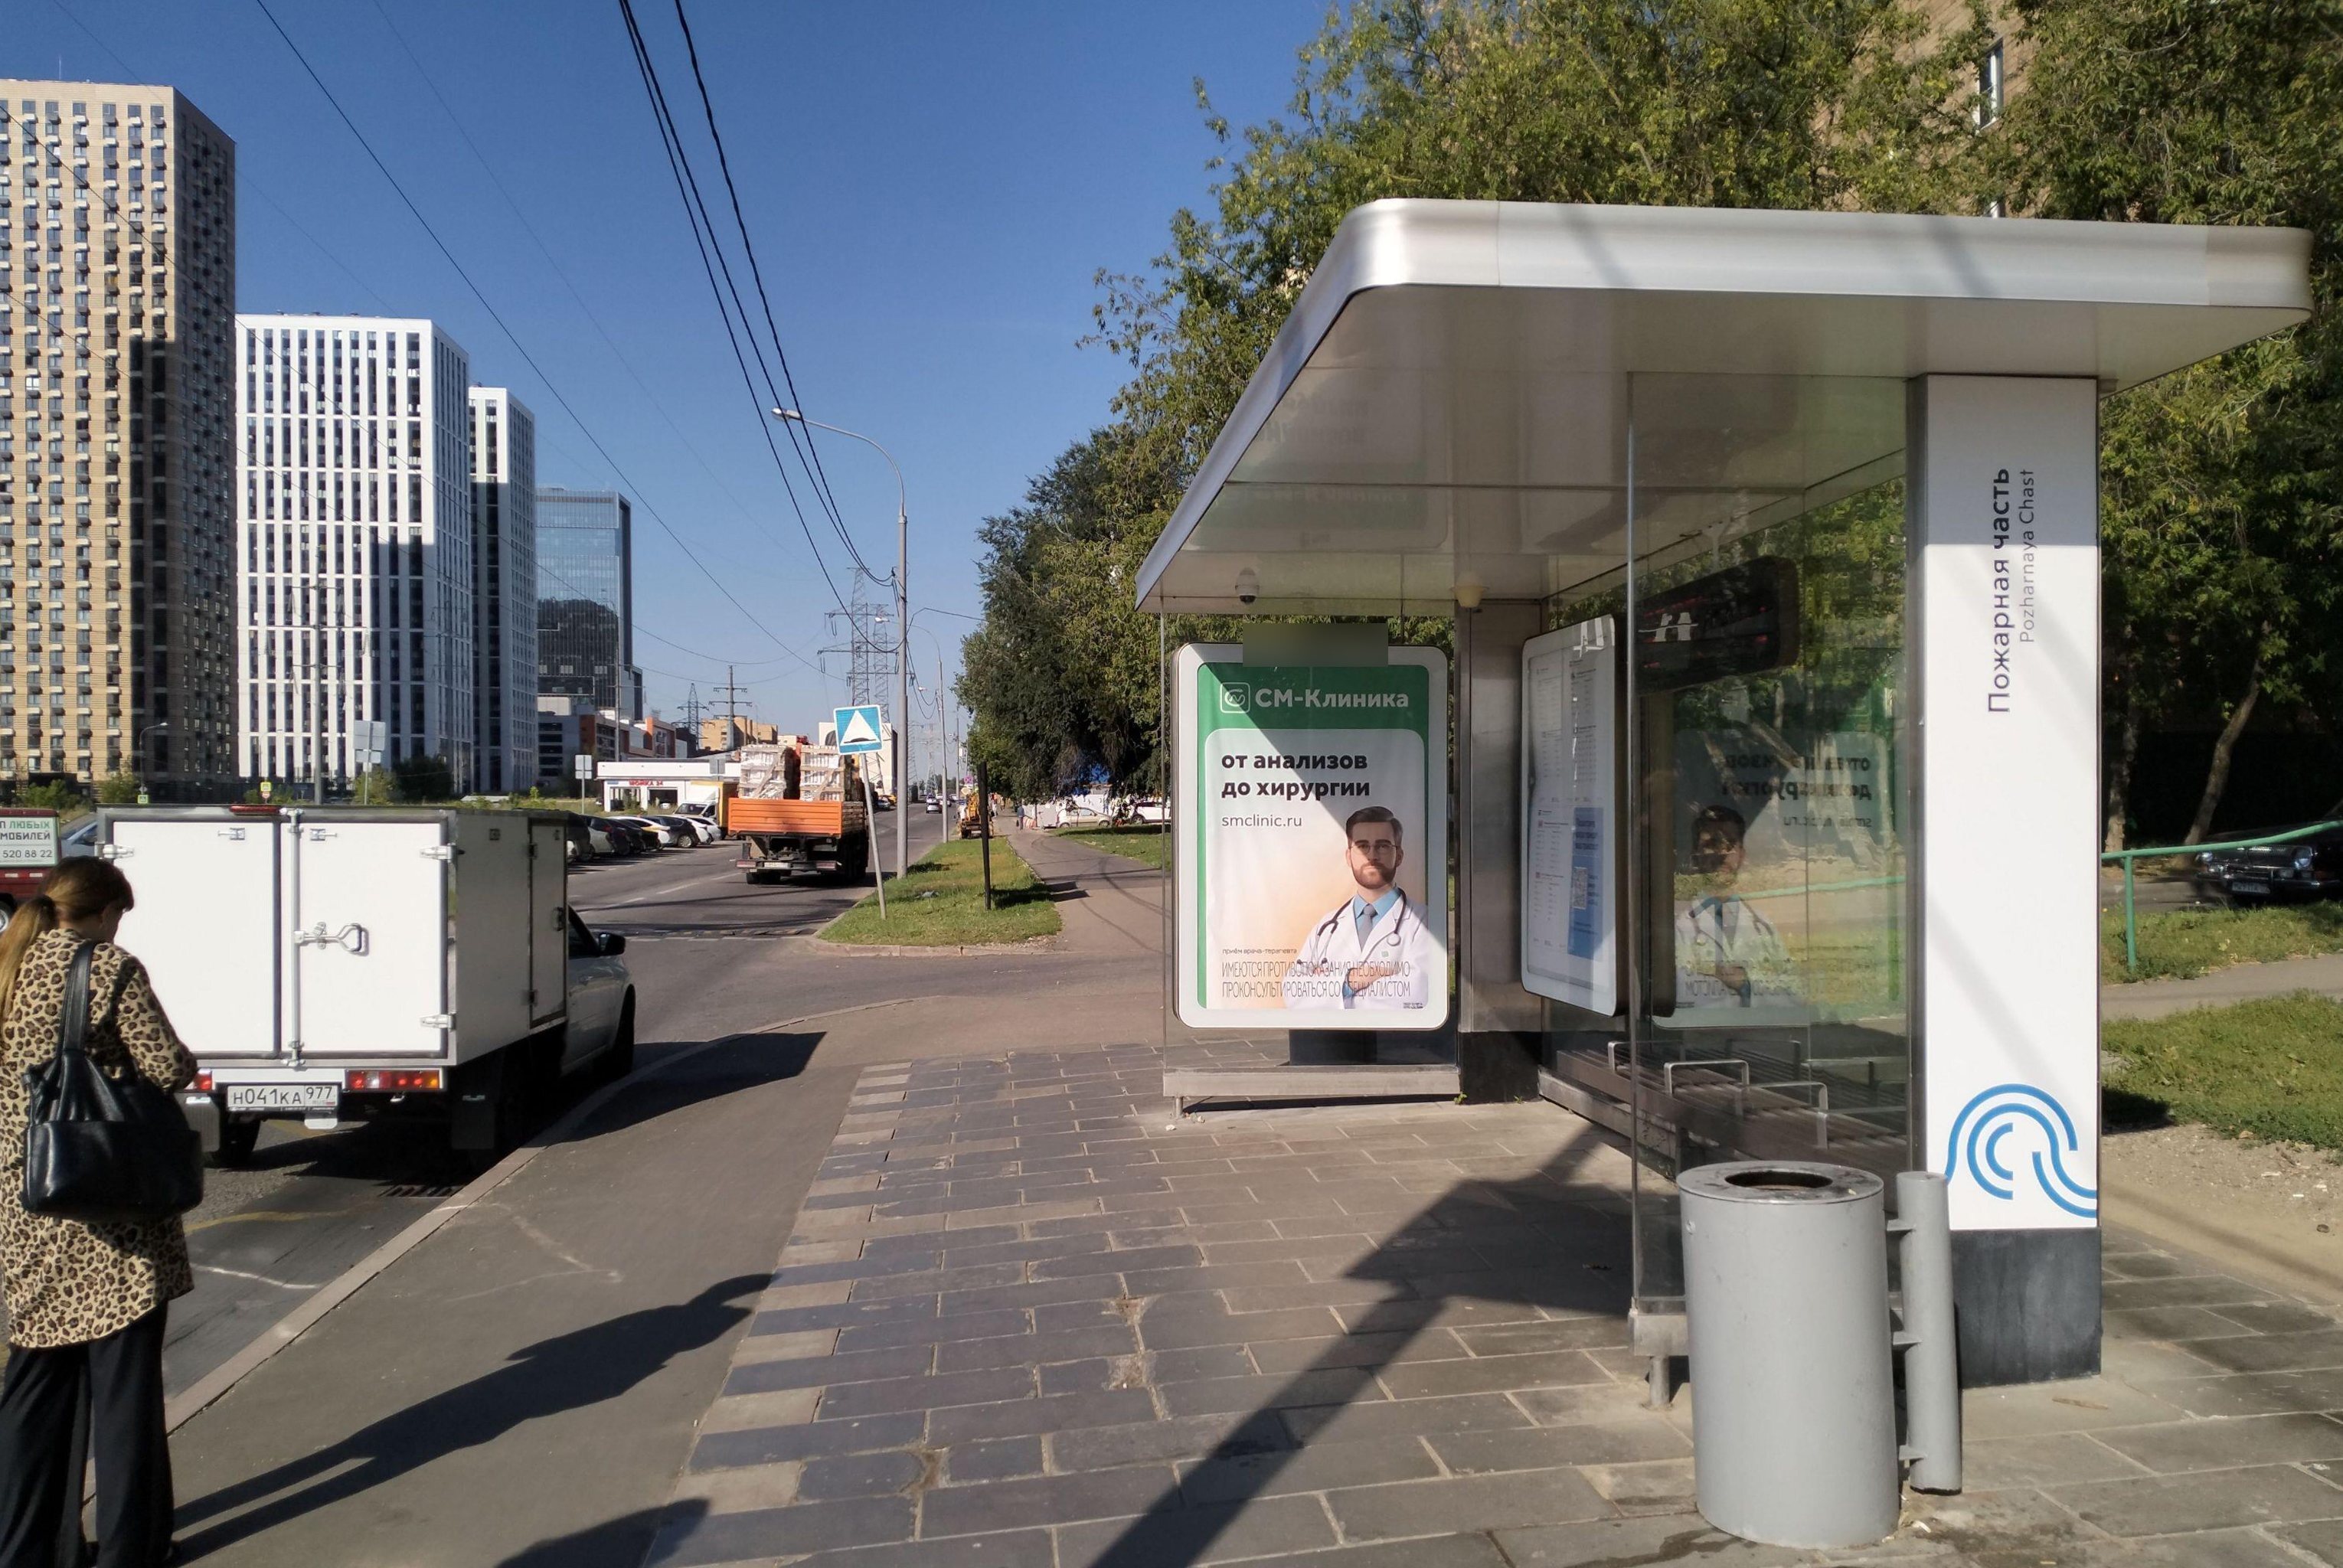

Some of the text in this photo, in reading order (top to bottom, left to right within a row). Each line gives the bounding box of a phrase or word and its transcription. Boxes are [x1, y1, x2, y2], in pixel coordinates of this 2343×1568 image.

[2018, 469, 2037, 642] Pozharnaya Chast
[1988, 469, 2015, 713] Пожарная часть
[1255, 688, 1409, 707] СМ-Клиника
[1221, 753, 1368, 769] от анализов
[1221, 782, 1370, 801] до хирургии
[9, 820, 51, 829] ЛЮБЫХ
[1221, 814, 1302, 827] smclinic.ru
[0, 831, 51, 841] МОБИЛЕЙ
[3, 850, 21, 858] 520
[25, 850, 37, 858] 88
[1222, 962, 1262, 978] ИМЕЮТСЯ
[1222, 981, 1327, 998] ПРОКОНСУЛЬТИРОВАТЬСЯ
[1328, 981, 1341, 998] СО
[233, 1086, 332, 1105] Н041КА 977
